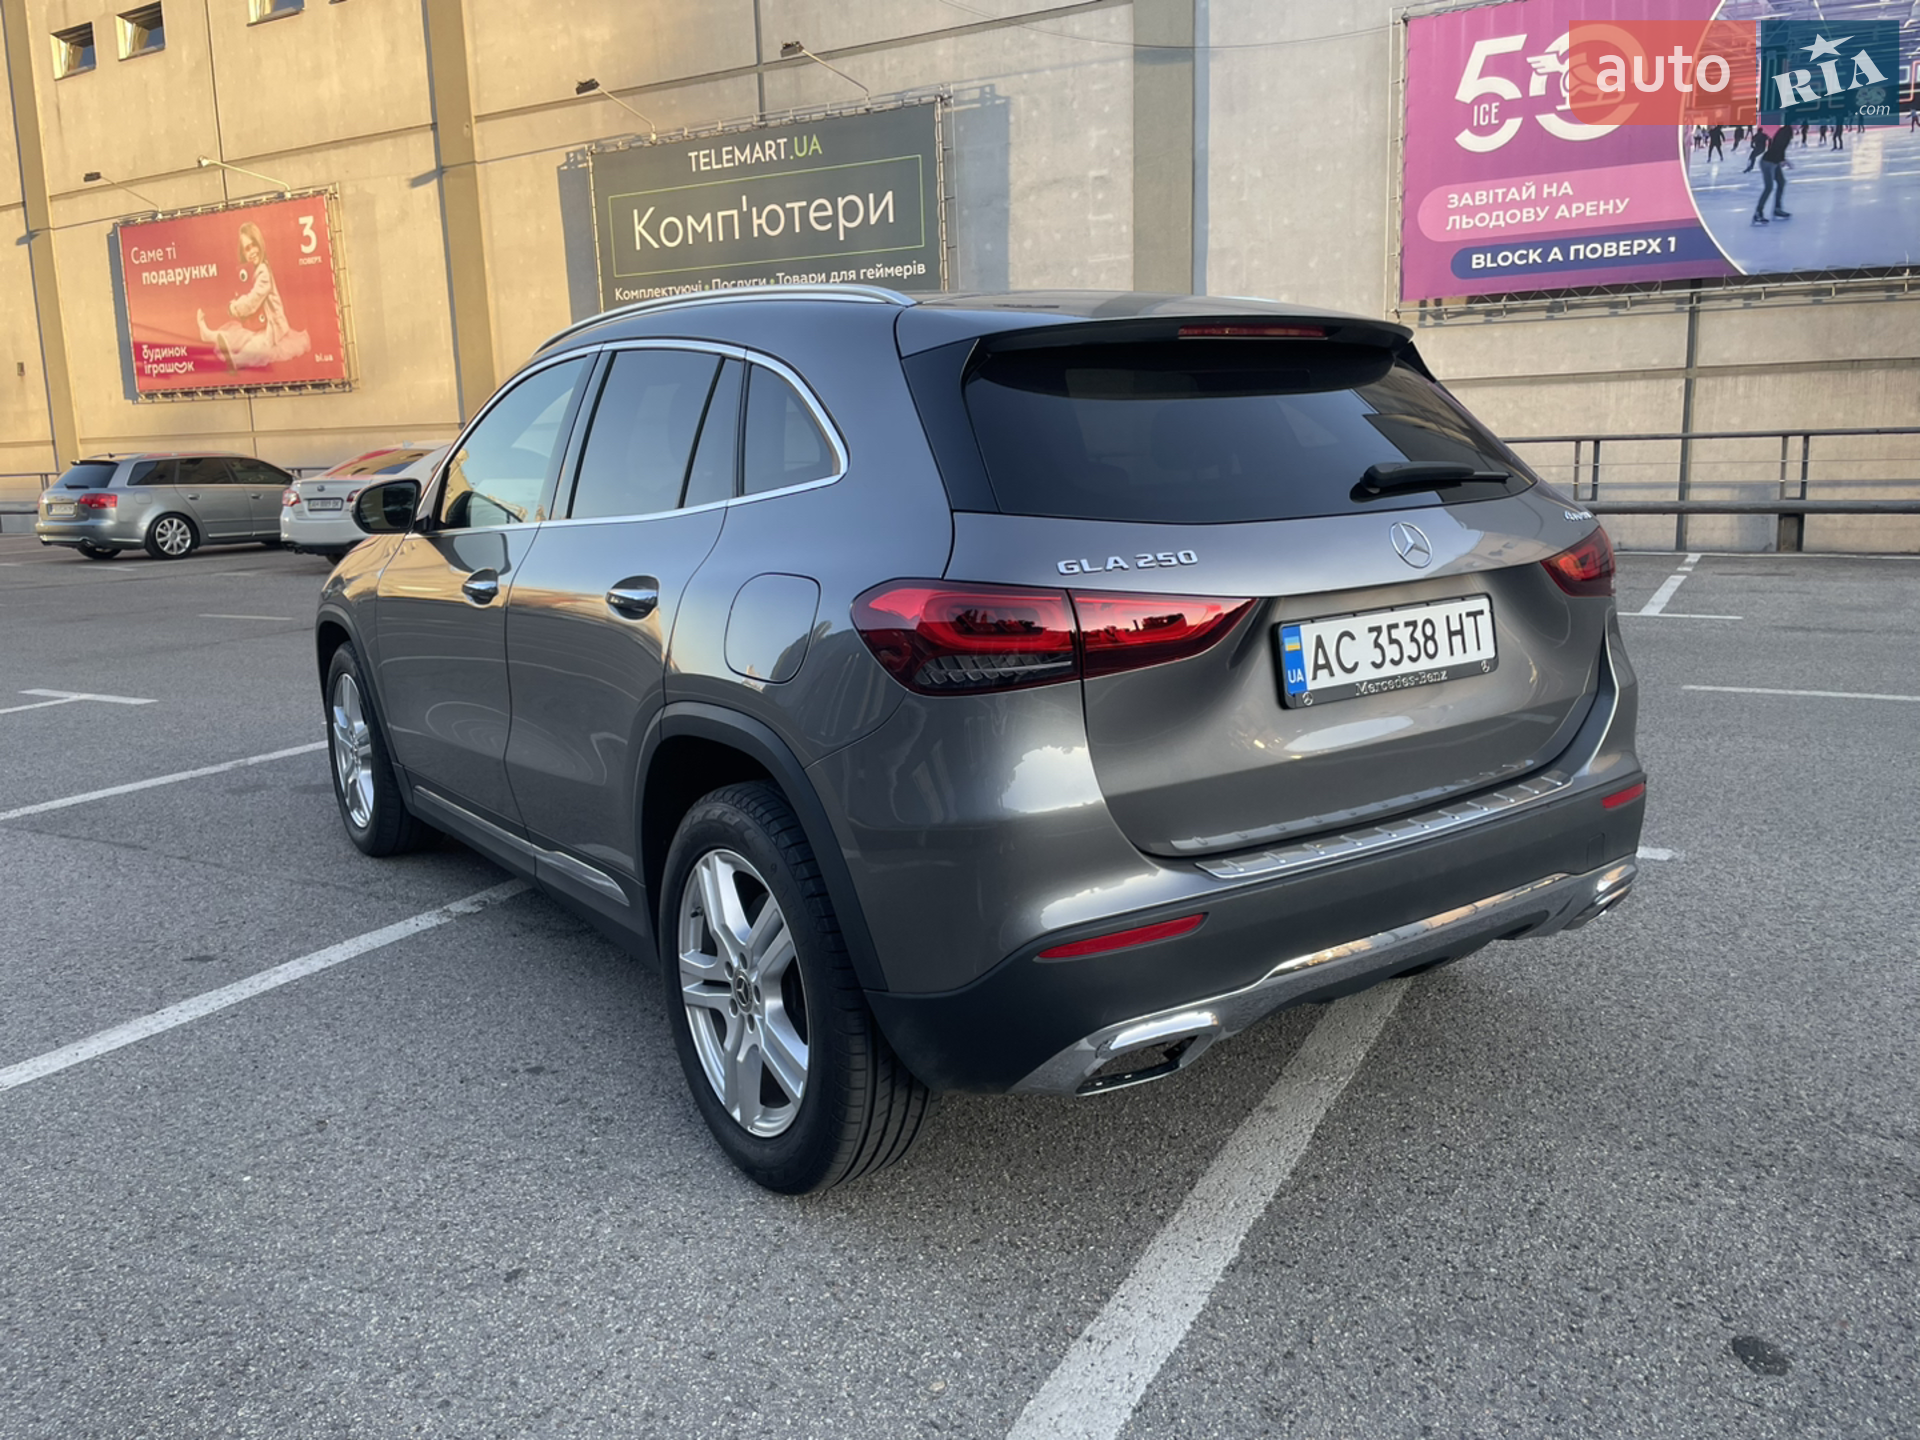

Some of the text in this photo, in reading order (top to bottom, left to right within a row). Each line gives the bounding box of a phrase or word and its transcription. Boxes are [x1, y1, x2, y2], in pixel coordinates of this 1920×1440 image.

[1473, 101, 1500, 127] ICE
[688, 134, 822, 172] TELEMART.UA
[1447, 181, 1574, 208] ЗАВІТАЙ НА
[632, 190, 895, 251] Комп'ютери
[1445, 198, 1630, 231] ЛЬОДОВУ АРЕНУ
[298, 215, 317, 254] 3
[130, 242, 177, 265] Саме ті
[1471, 248, 1543, 269] BLOCK
[1569, 237, 1662, 261] ПОВЕРХ
[1667, 236, 1677, 252] 1
[142, 263, 218, 286] подарунки
[614, 280, 702, 301] Комплектуючі
[776, 271, 826, 285] Товари
[829, 269, 857, 284] для
[860, 260, 926, 279] геймерів
[142, 344, 188, 363] будинок
[1057, 550, 1199, 576] GLA 250
[1311, 609, 1485, 681] AC 3538 HT
[1287, 668, 1305, 684] UA
[1354, 669, 1448, 697] Mercedes-Benz
